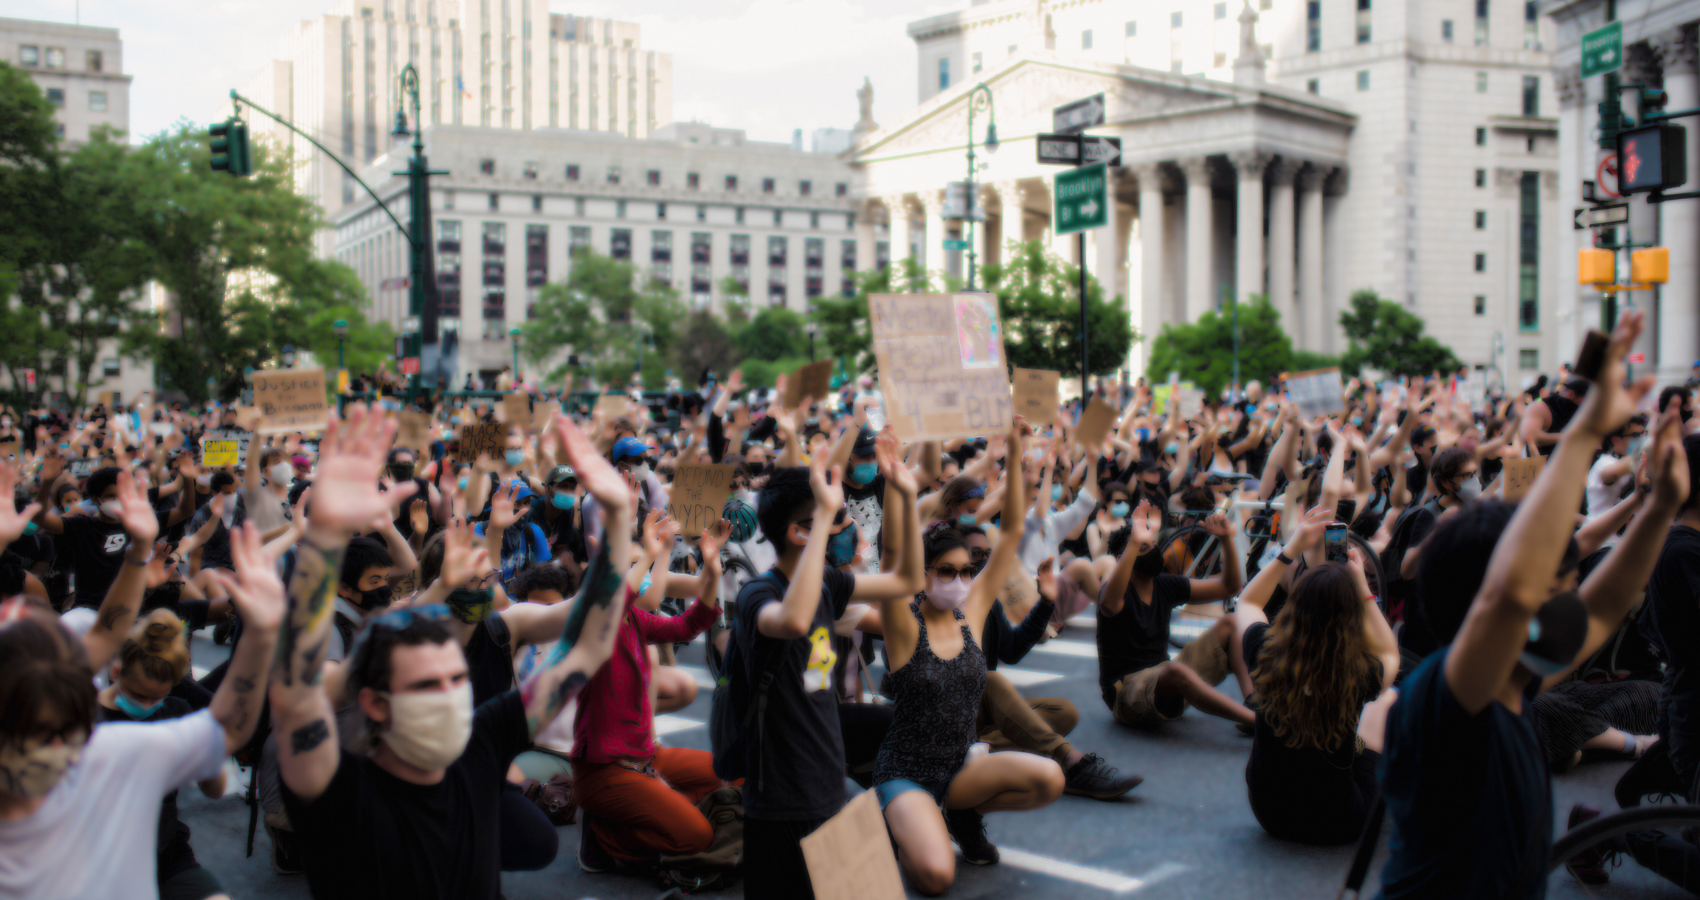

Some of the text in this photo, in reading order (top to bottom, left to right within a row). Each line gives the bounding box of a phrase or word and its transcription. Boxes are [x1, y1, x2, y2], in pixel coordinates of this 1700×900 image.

[1057, 102, 1098, 128] ONE WAY
[1044, 142, 1110, 157] ONE WAY
[1058, 177, 1102, 199] Brooklyn
[1062, 206, 1072, 221] Br
[258, 377, 320, 392] Justice
[906, 396, 1015, 431] 4 BLM
[462, 423, 501, 438] BLACK
[205, 441, 237, 451] CAUTION
[461, 435, 497, 450] LIVES
[460, 446, 506, 462] MATTER
[675, 466, 724, 488] DEFUND
[1510, 465, 1537, 491] BLACK
[685, 488, 703, 502] THE
[669, 503, 716, 531] NYPD
